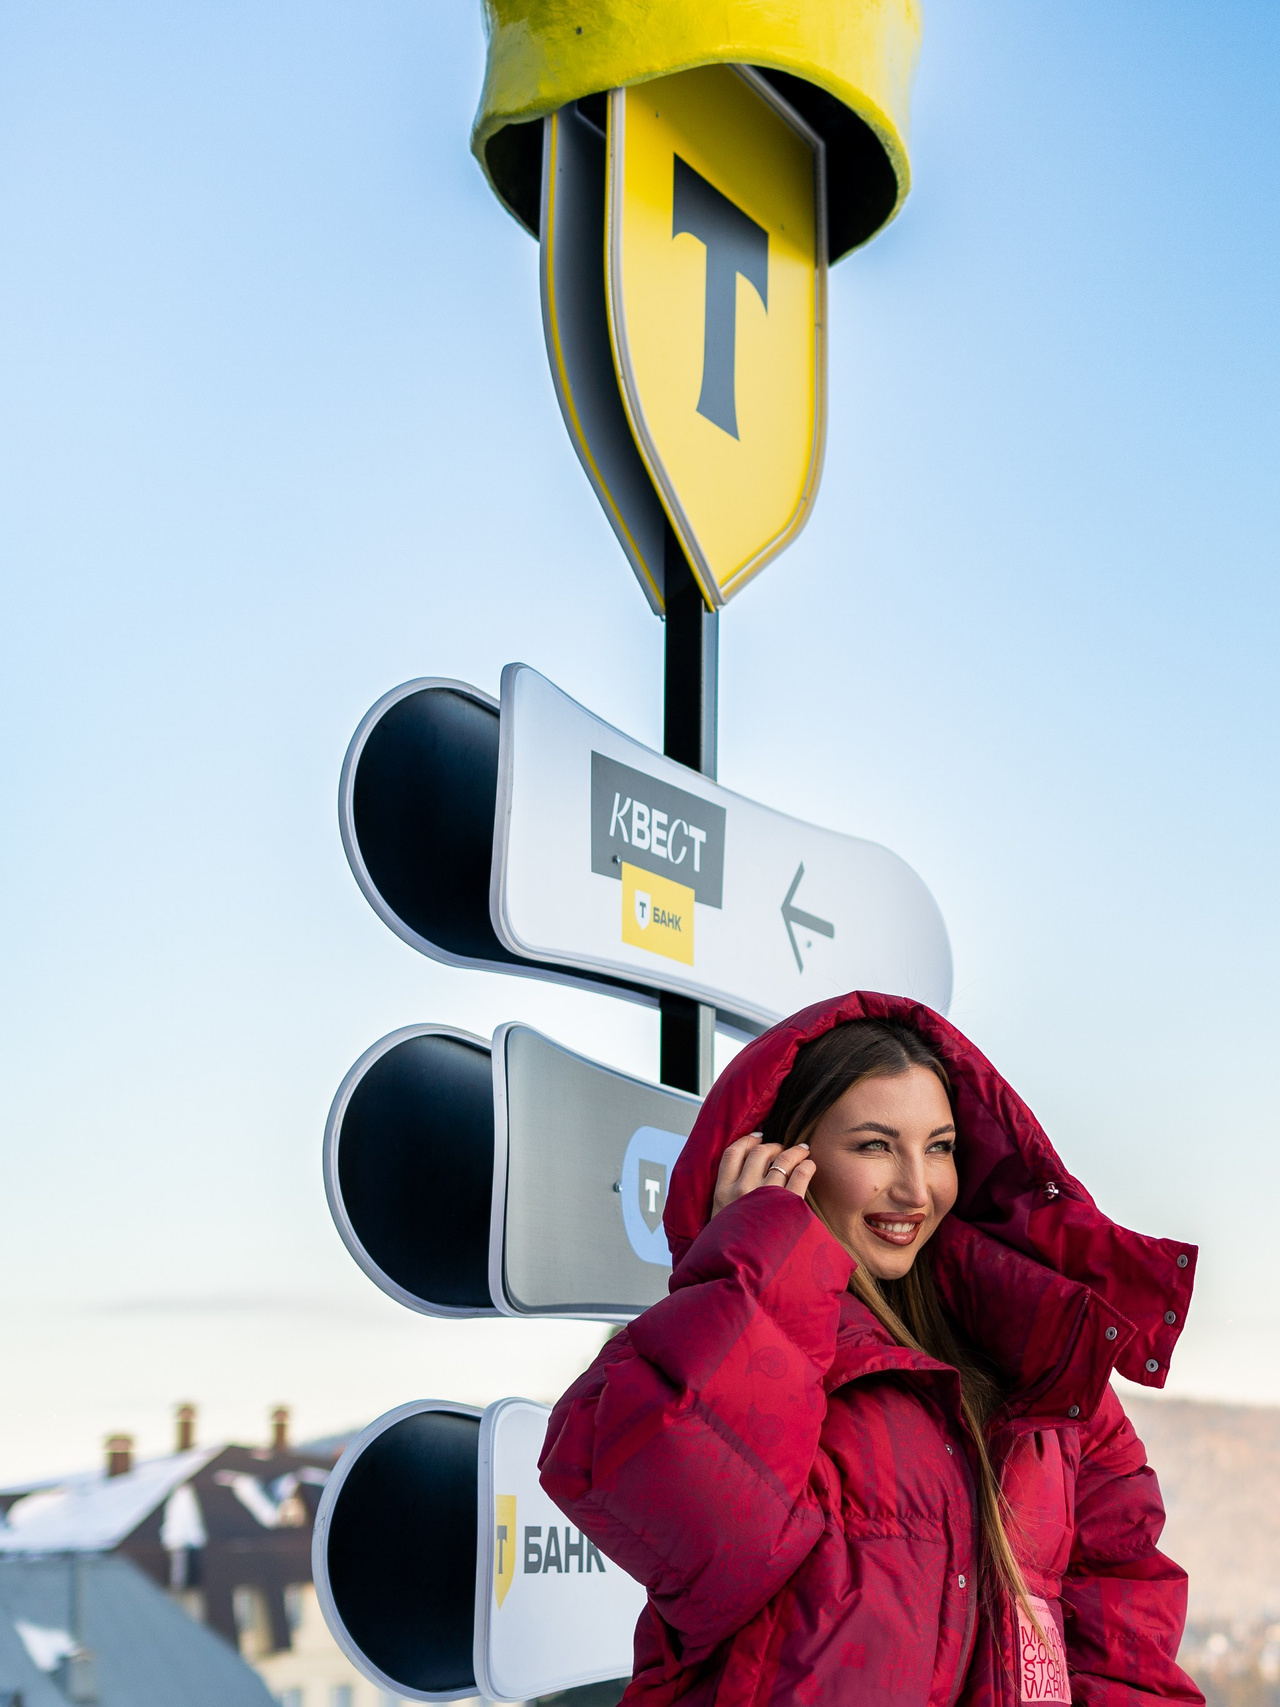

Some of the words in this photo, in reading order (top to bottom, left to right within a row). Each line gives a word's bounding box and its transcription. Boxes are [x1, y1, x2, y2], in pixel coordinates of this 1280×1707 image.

[671, 151, 769, 442] Т
[608, 791, 707, 873] КВЕСТ
[653, 906, 682, 932] БАНК
[645, 1178, 660, 1213] Т
[1023, 1679, 1066, 1700] WARM
